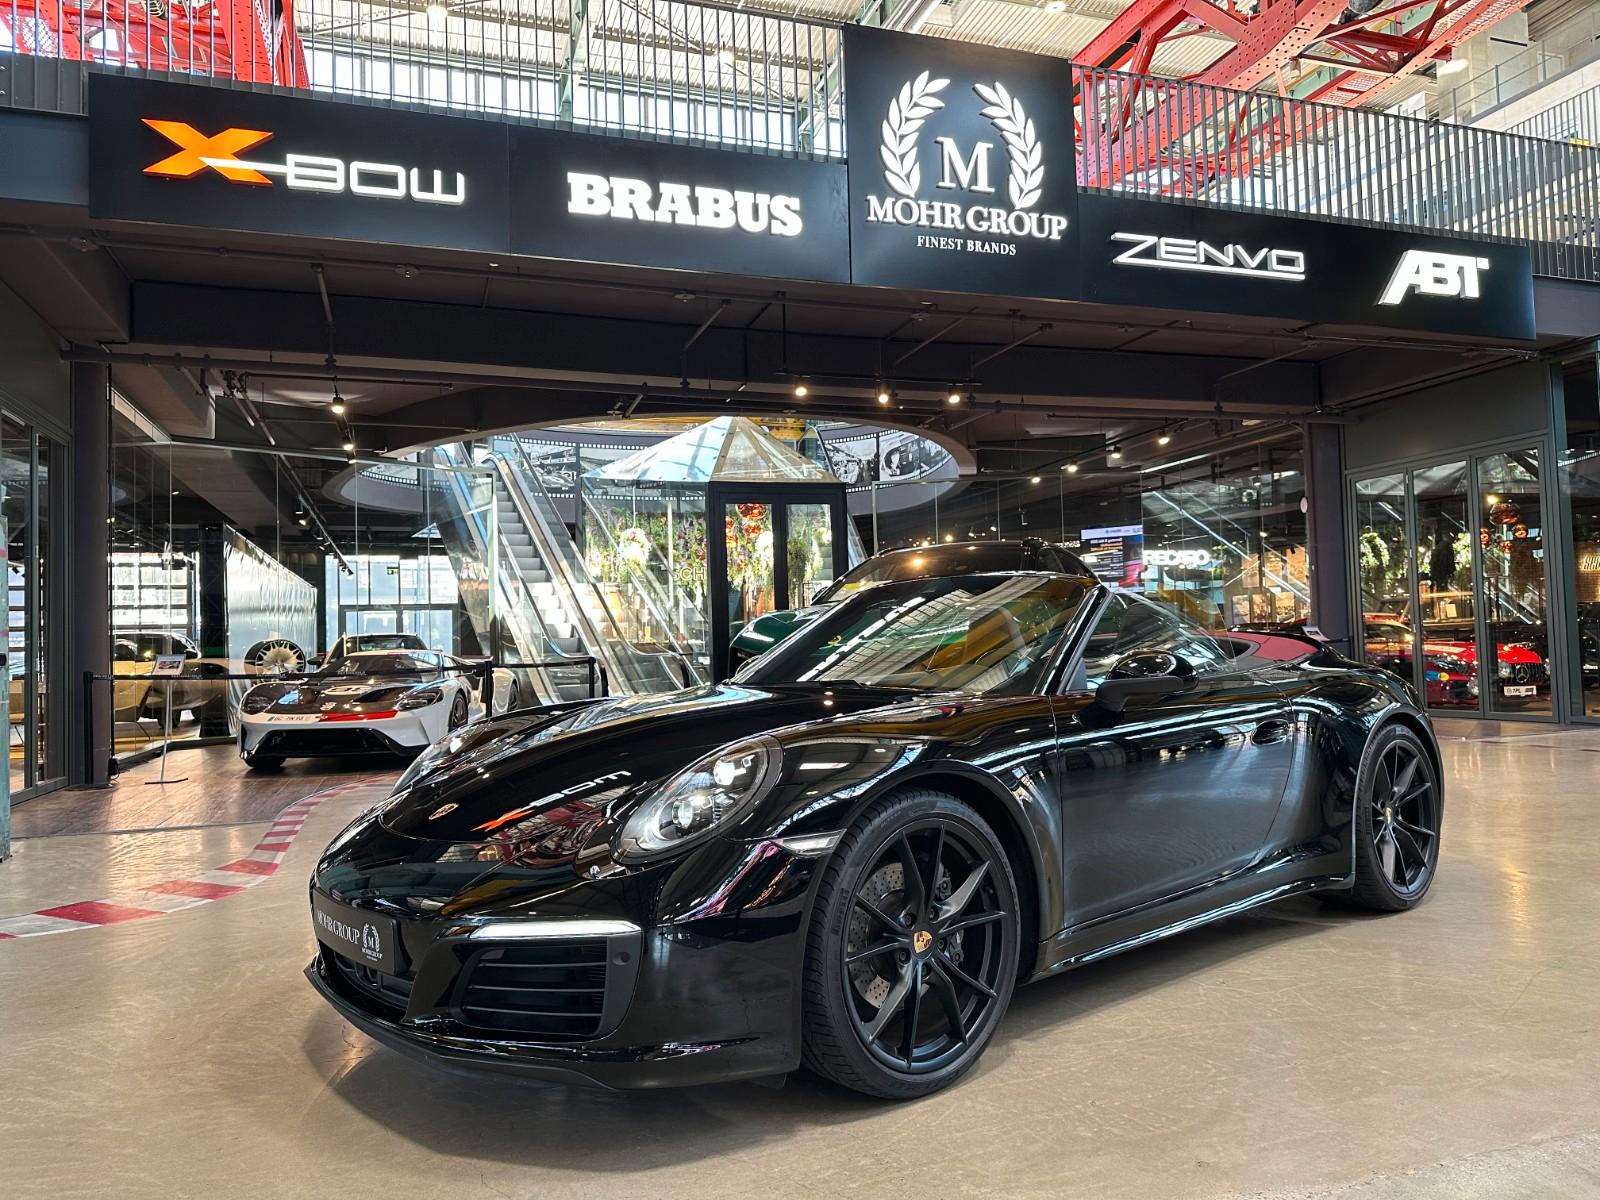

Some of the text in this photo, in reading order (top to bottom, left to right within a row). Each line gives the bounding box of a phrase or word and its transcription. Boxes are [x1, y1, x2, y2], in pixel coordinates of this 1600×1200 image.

[935, 136, 995, 193] M
[567, 171, 803, 237] BRABUS
[867, 195, 1068, 240] MOHR GROUP
[917, 235, 1017, 256] FINEST BRANDS
[1110, 232, 1306, 281] ZENVO
[1377, 249, 1490, 305] ABT
[333, 920, 360, 944] GROUP
